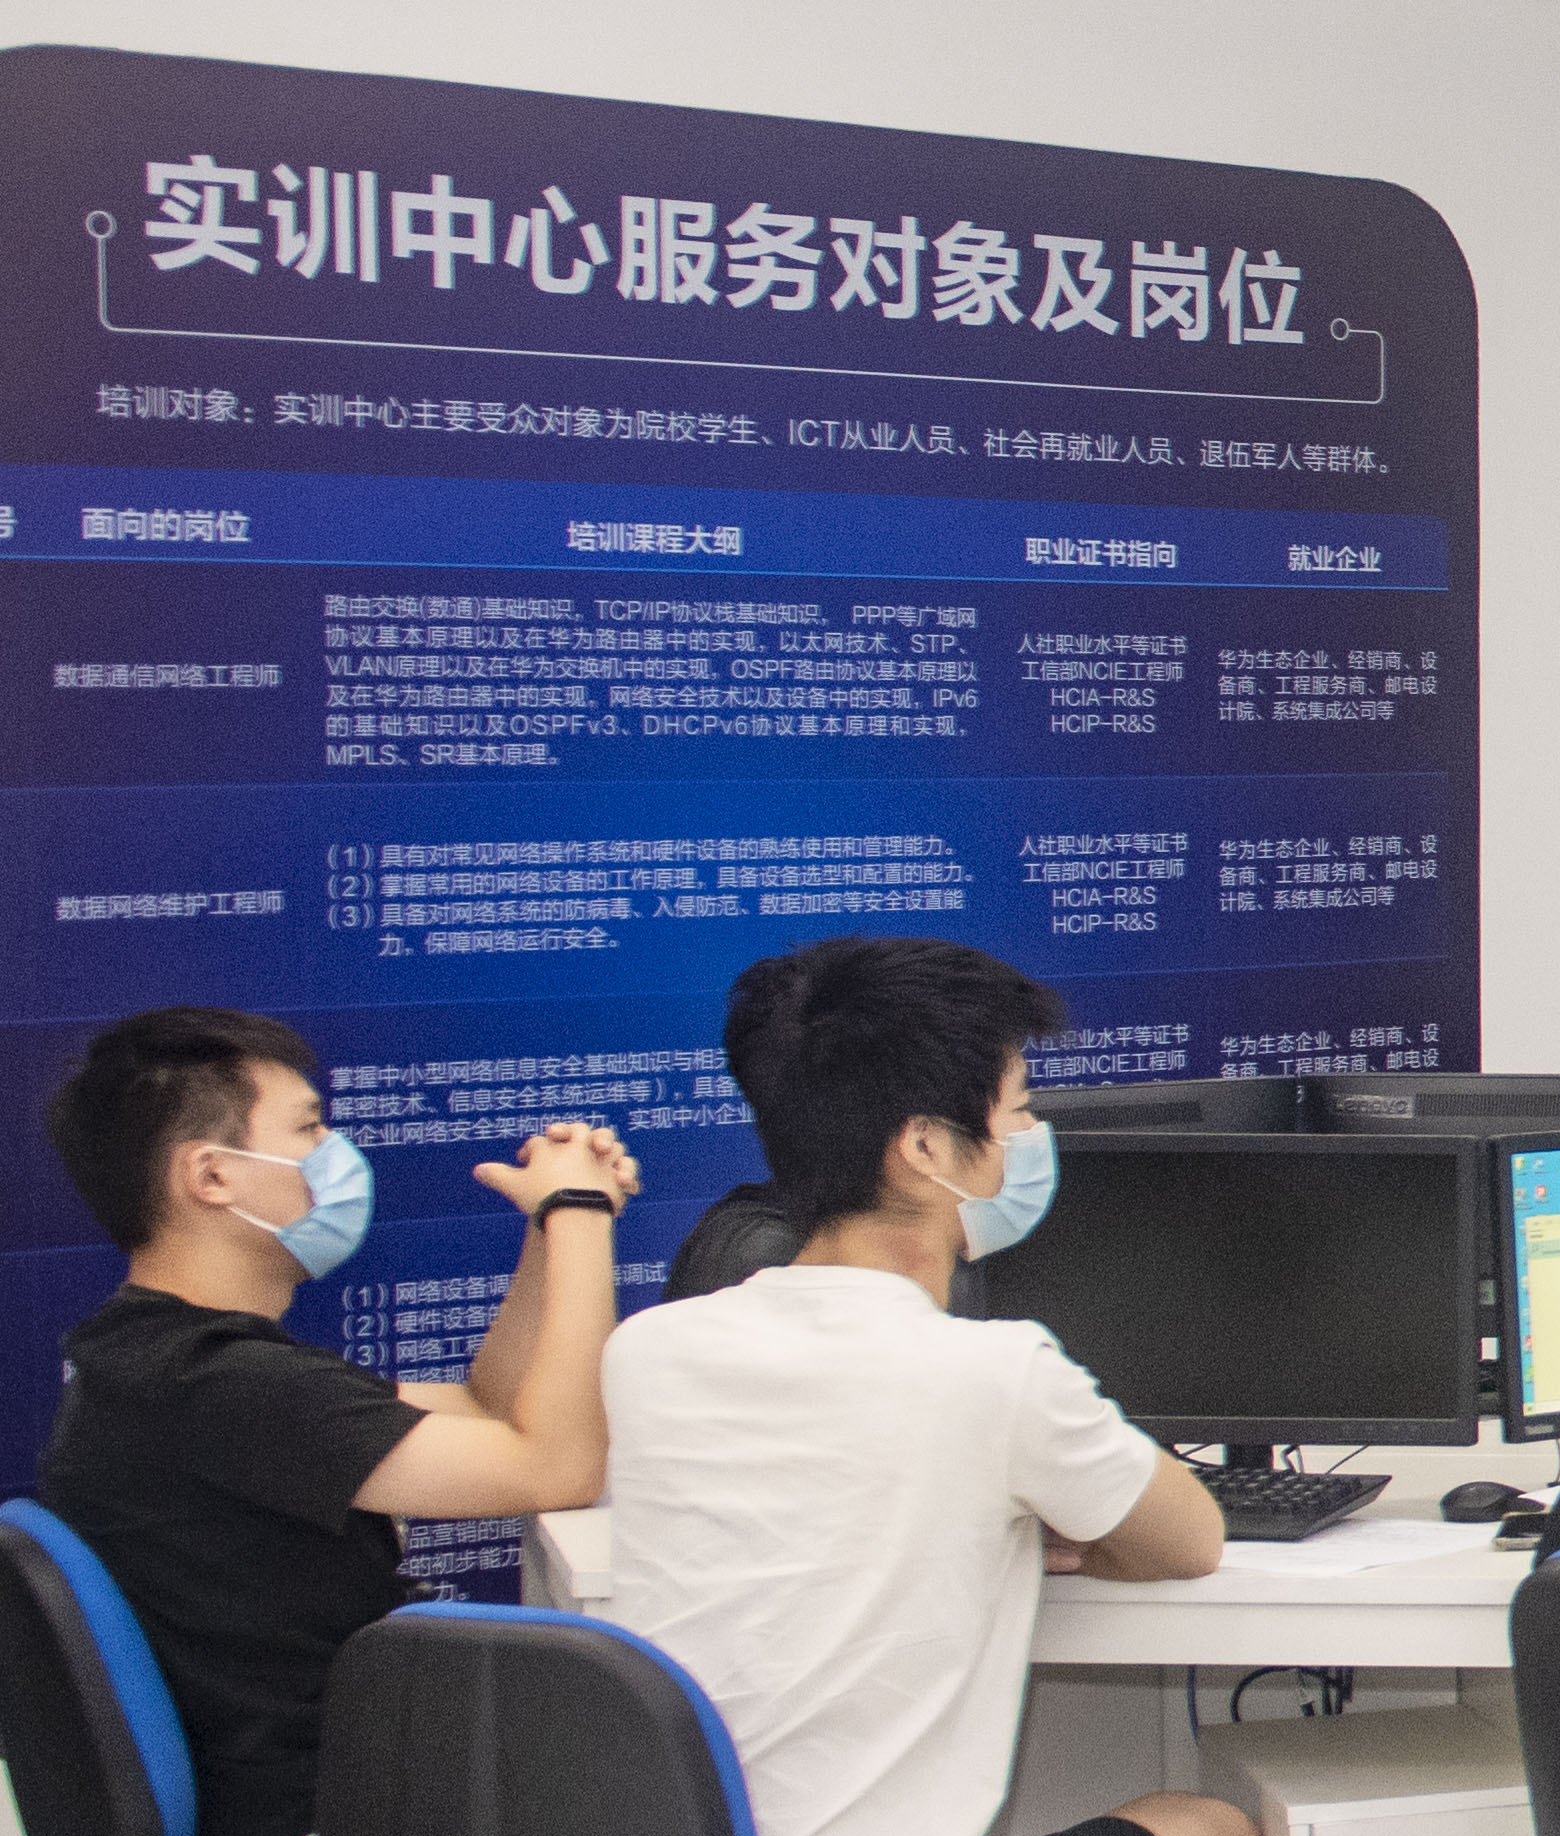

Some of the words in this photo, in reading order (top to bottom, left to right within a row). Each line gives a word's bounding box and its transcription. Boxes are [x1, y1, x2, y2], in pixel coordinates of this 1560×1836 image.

[144, 154, 1305, 346] 实训中心服务对象及岗位
[82, 508, 251, 543] 面向的岗位
[567, 521, 743, 556] 培训课程大纲
[1025, 537, 1178, 570] 职业证书指向
[1288, 544, 1382, 574] 就业企业
[1017, 634, 1188, 656] 人社职业水平等证书
[1021, 660, 1184, 683] 工信部NCIE工程师
[1217, 649, 1439, 672] 华为生态企业、经销商、设
[54, 663, 282, 688] 数据通信网络工程师
[1217, 674, 1439, 697] 备商、工程服务商、邮电设
[1050, 687, 1156, 708] HCIA-R&S
[1050, 713, 1156, 734] HCIP-R&S
[1217, 700, 1395, 722] 计院、系统集成公司等
[1019, 832, 1189, 856] 人社职业水平等证书
[1218, 834, 1439, 862] 华为生态企业、经销商、设
[1023, 858, 1185, 884] 工信部NCIE工程师
[1219, 860, 1439, 888] 备商、工程服务商、邮电设
[56, 890, 285, 921] 数据网络维护工程师
[1052, 886, 1157, 908] HCIA-R&S
[1219, 886, 1396, 912] 计院、系统集成公司等
[1052, 912, 1157, 934] HCIP-R&S
[1219, 1023, 1440, 1057] 华为生态企业、经销商、设
[1026, 1049, 1187, 1079] 工信部NCIE工程师
